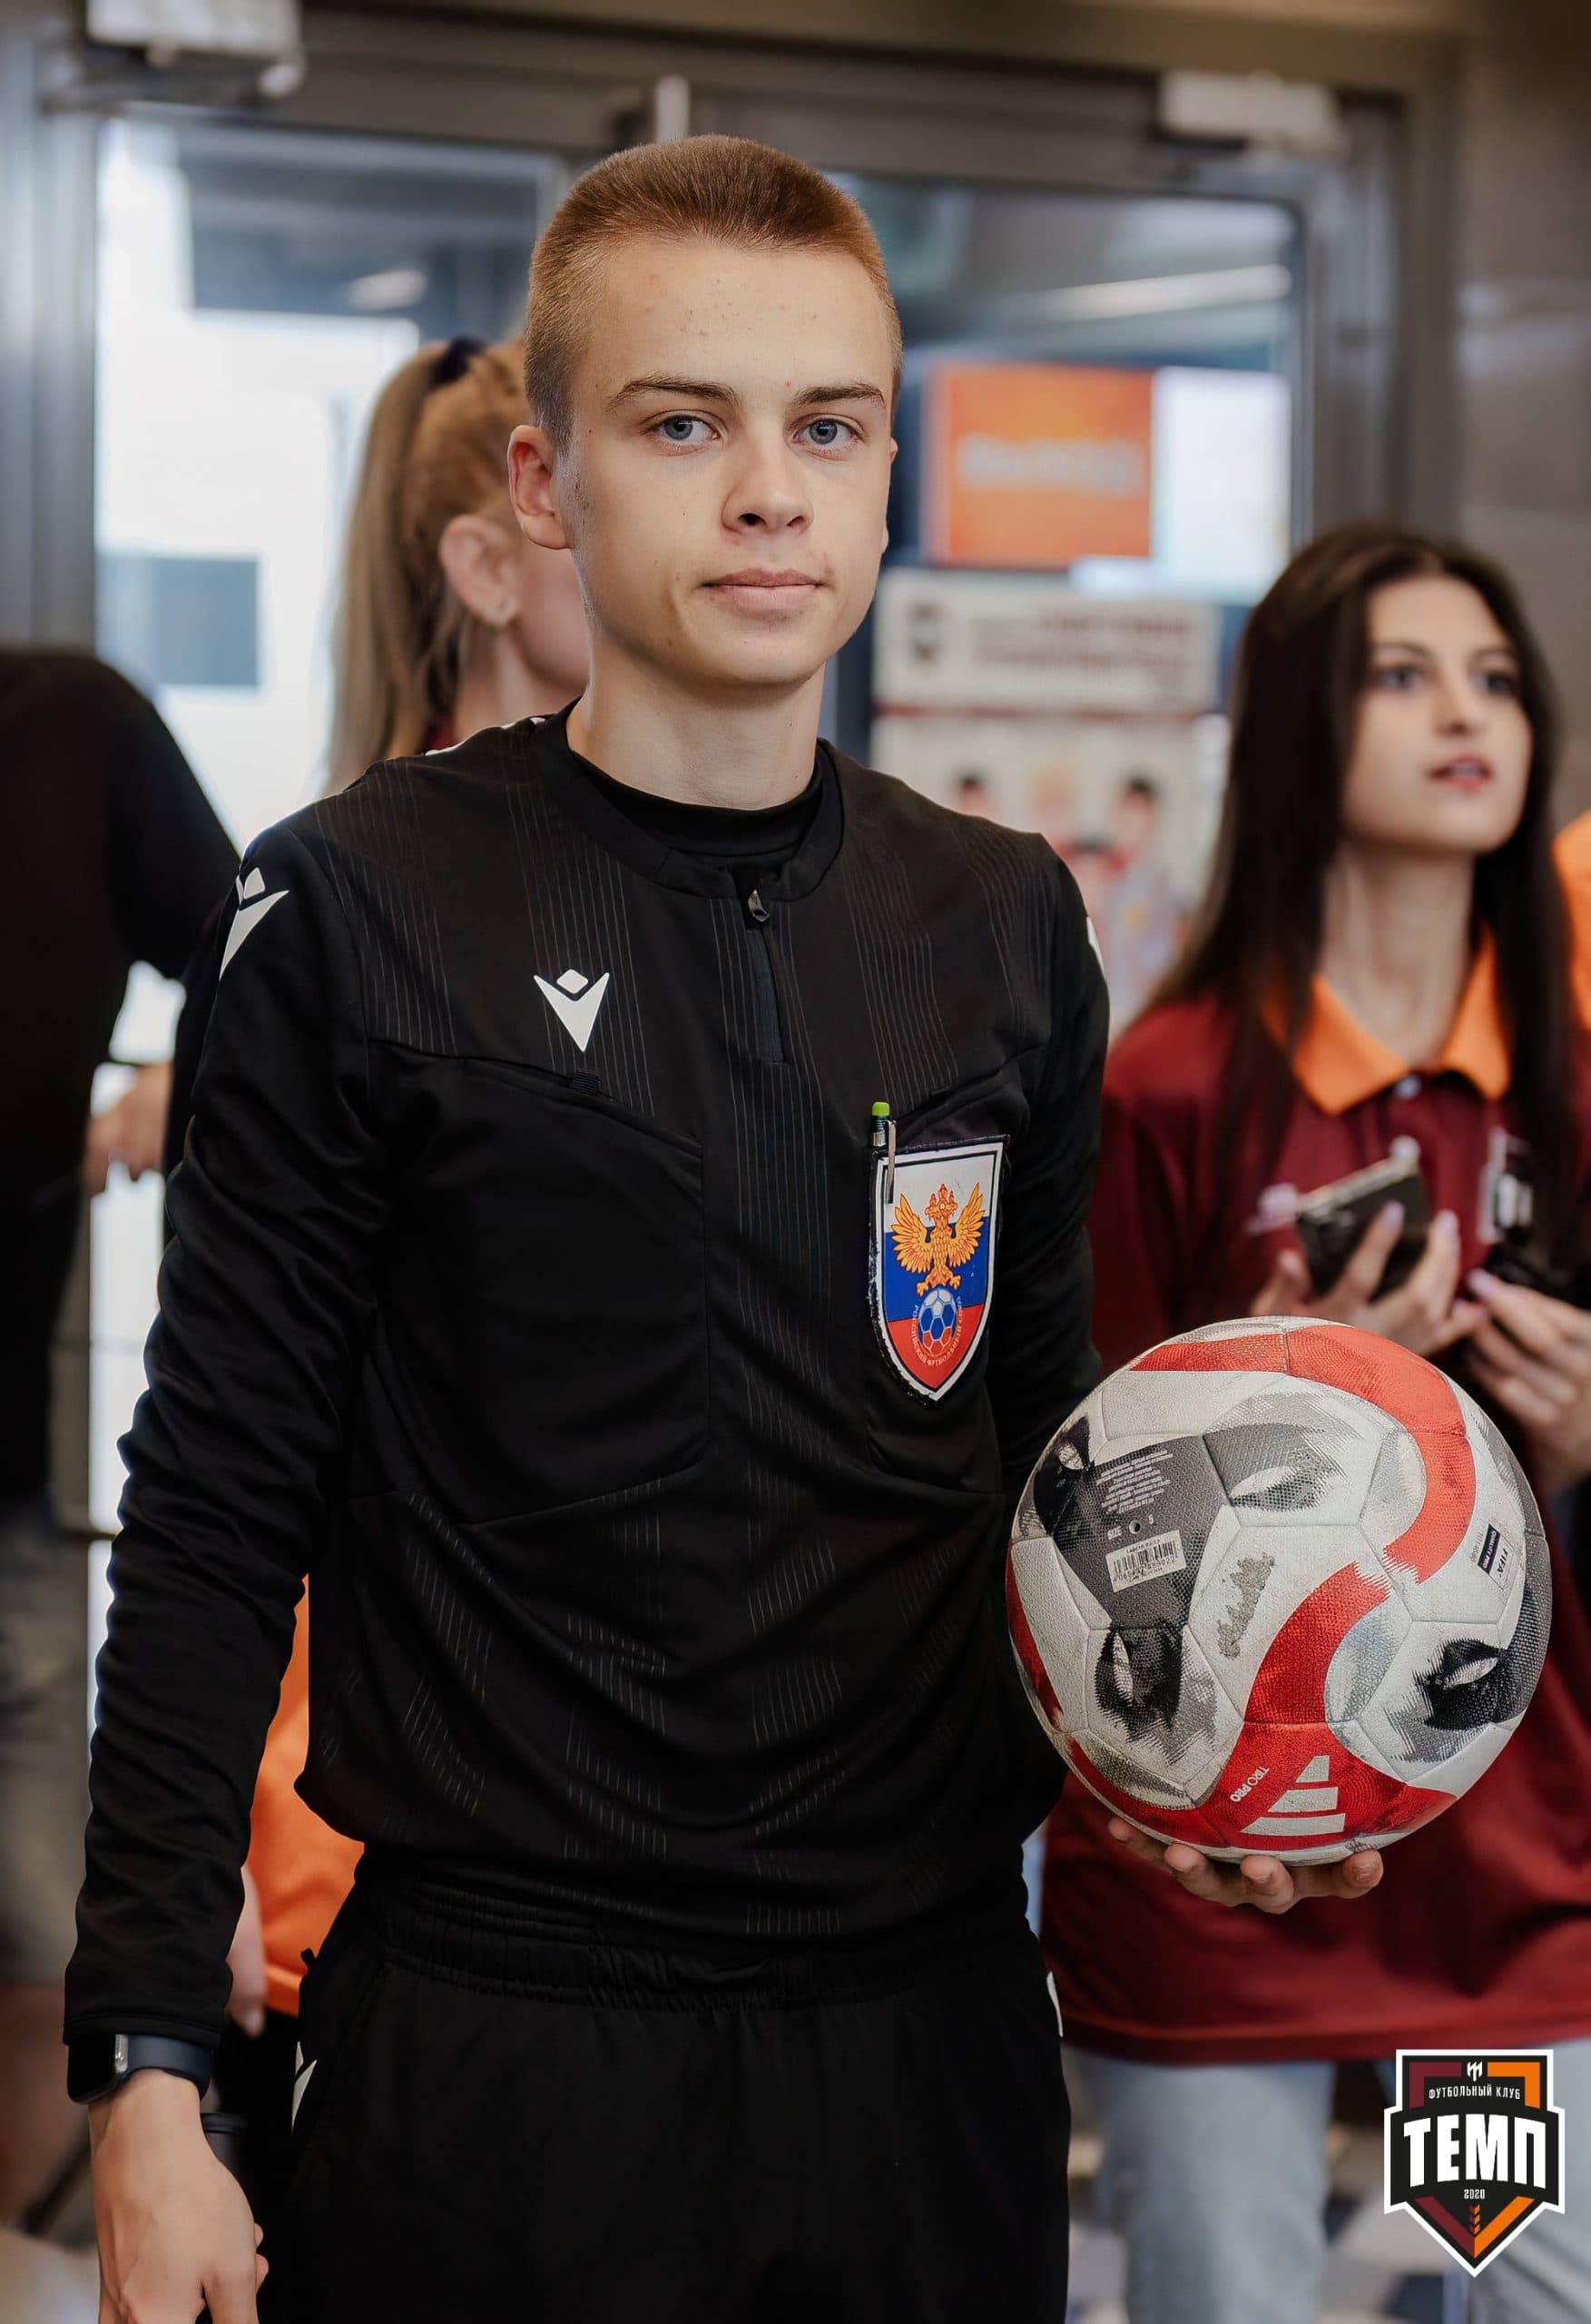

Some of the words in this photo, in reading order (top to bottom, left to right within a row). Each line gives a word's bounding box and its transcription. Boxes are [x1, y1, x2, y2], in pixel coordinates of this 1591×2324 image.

[1107, 1526, 1123, 1541] SIZE
[1148, 1514, 1154, 1524] 5
[1487, 1531, 1497, 1554] QUALITY
[1482, 1553, 1491, 1569] PRO
[1497, 1548, 1508, 1573] FIFA
[1247, 1766, 1270, 1786] TIRO
[1230, 1783, 1252, 1802] PRO
